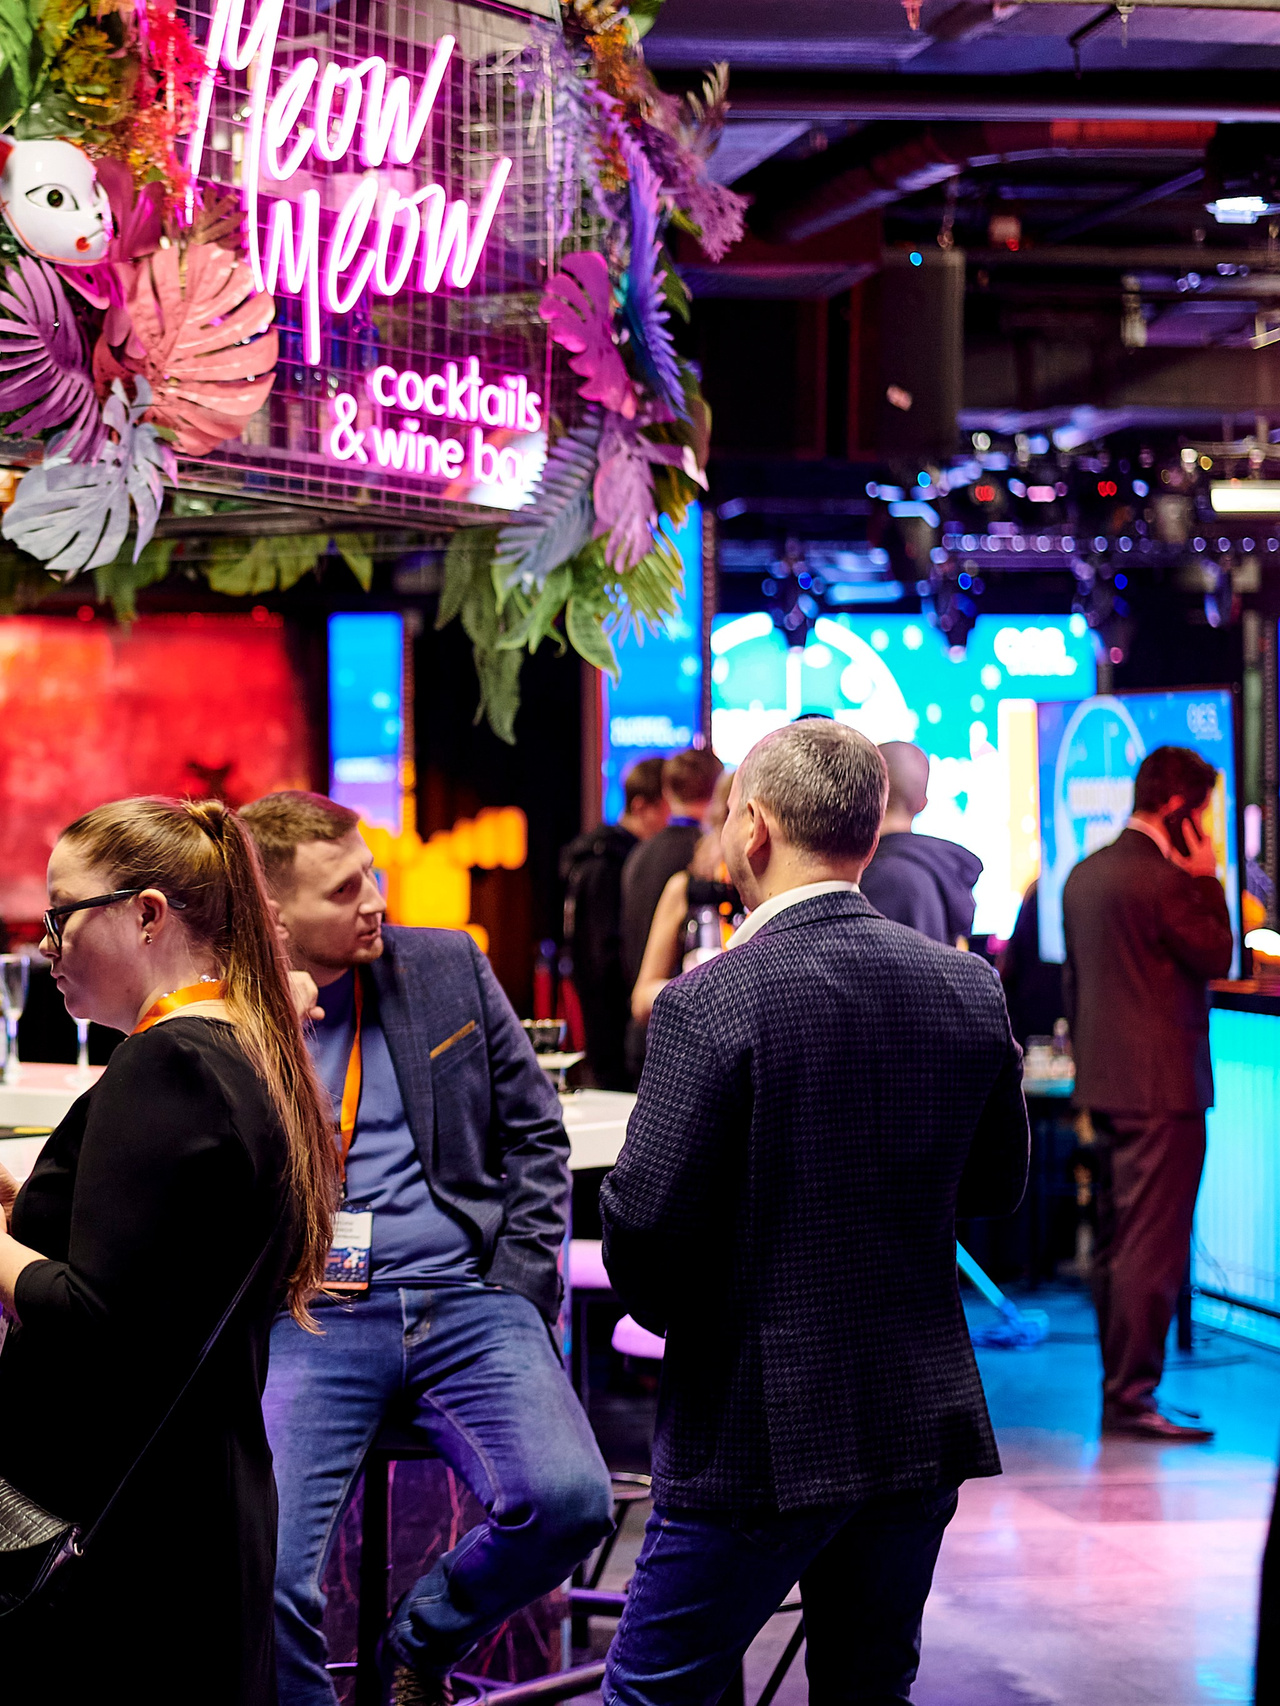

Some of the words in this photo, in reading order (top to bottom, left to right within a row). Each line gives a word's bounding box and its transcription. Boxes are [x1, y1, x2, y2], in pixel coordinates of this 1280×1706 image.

[184, 0, 456, 293] Meow
[265, 157, 513, 366] Meow
[328, 392, 369, 465] &
[370, 417, 464, 480] wine
[371, 355, 542, 432] cocktails
